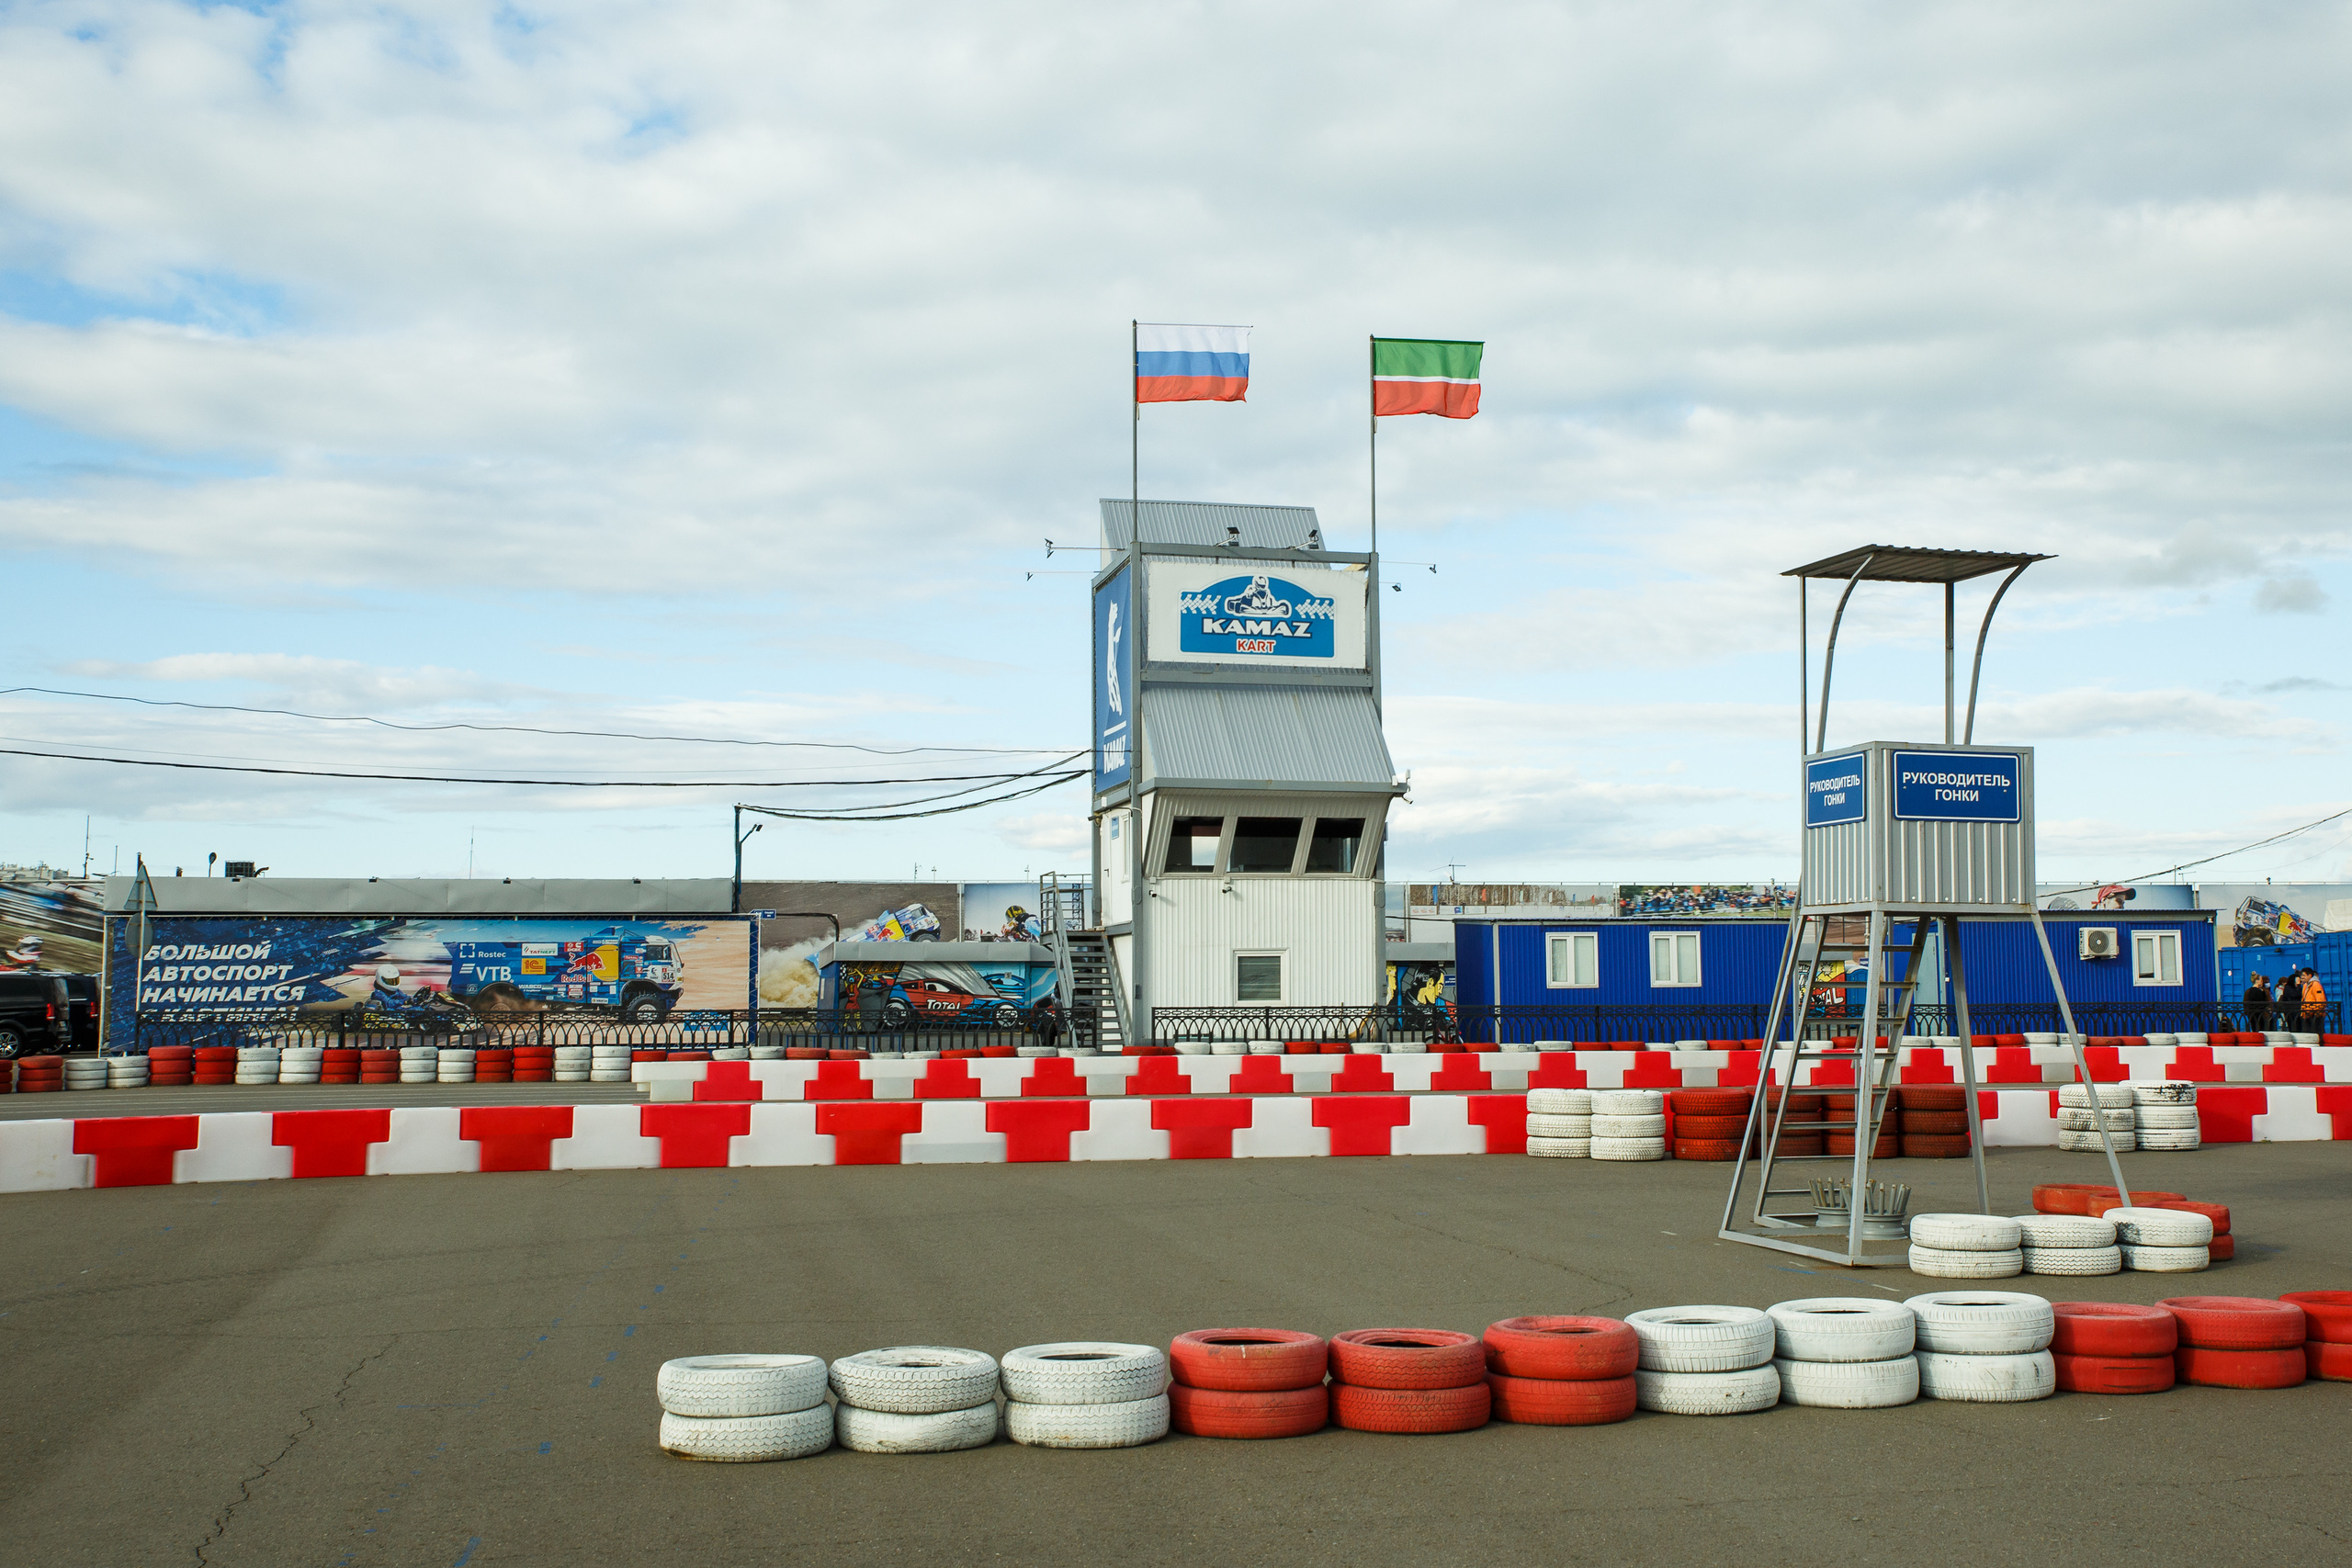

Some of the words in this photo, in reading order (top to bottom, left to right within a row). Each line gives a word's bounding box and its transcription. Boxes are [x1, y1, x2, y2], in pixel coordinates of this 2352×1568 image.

[1203, 618, 1312, 637] KAMAZ
[1238, 639, 1275, 652] KART
[1103, 735, 1126, 774] KAMAZ
[1810, 774, 1860, 794] РУКОВОДИТЕЛЬ
[1902, 772, 2010, 787] РУКОВОДИТЕЛЬ
[1824, 792, 1846, 807] ГОНКИ
[1935, 788, 1979, 802] ГОНКИ
[143, 940, 272, 961] БОЛЬШОЙ
[141, 964, 294, 982] АВТОСПОРТ
[476, 966, 512, 981] VTB
[561, 975, 577, 983] Red
[141, 986, 307, 1003] НАЧИНАЕТСЯ
